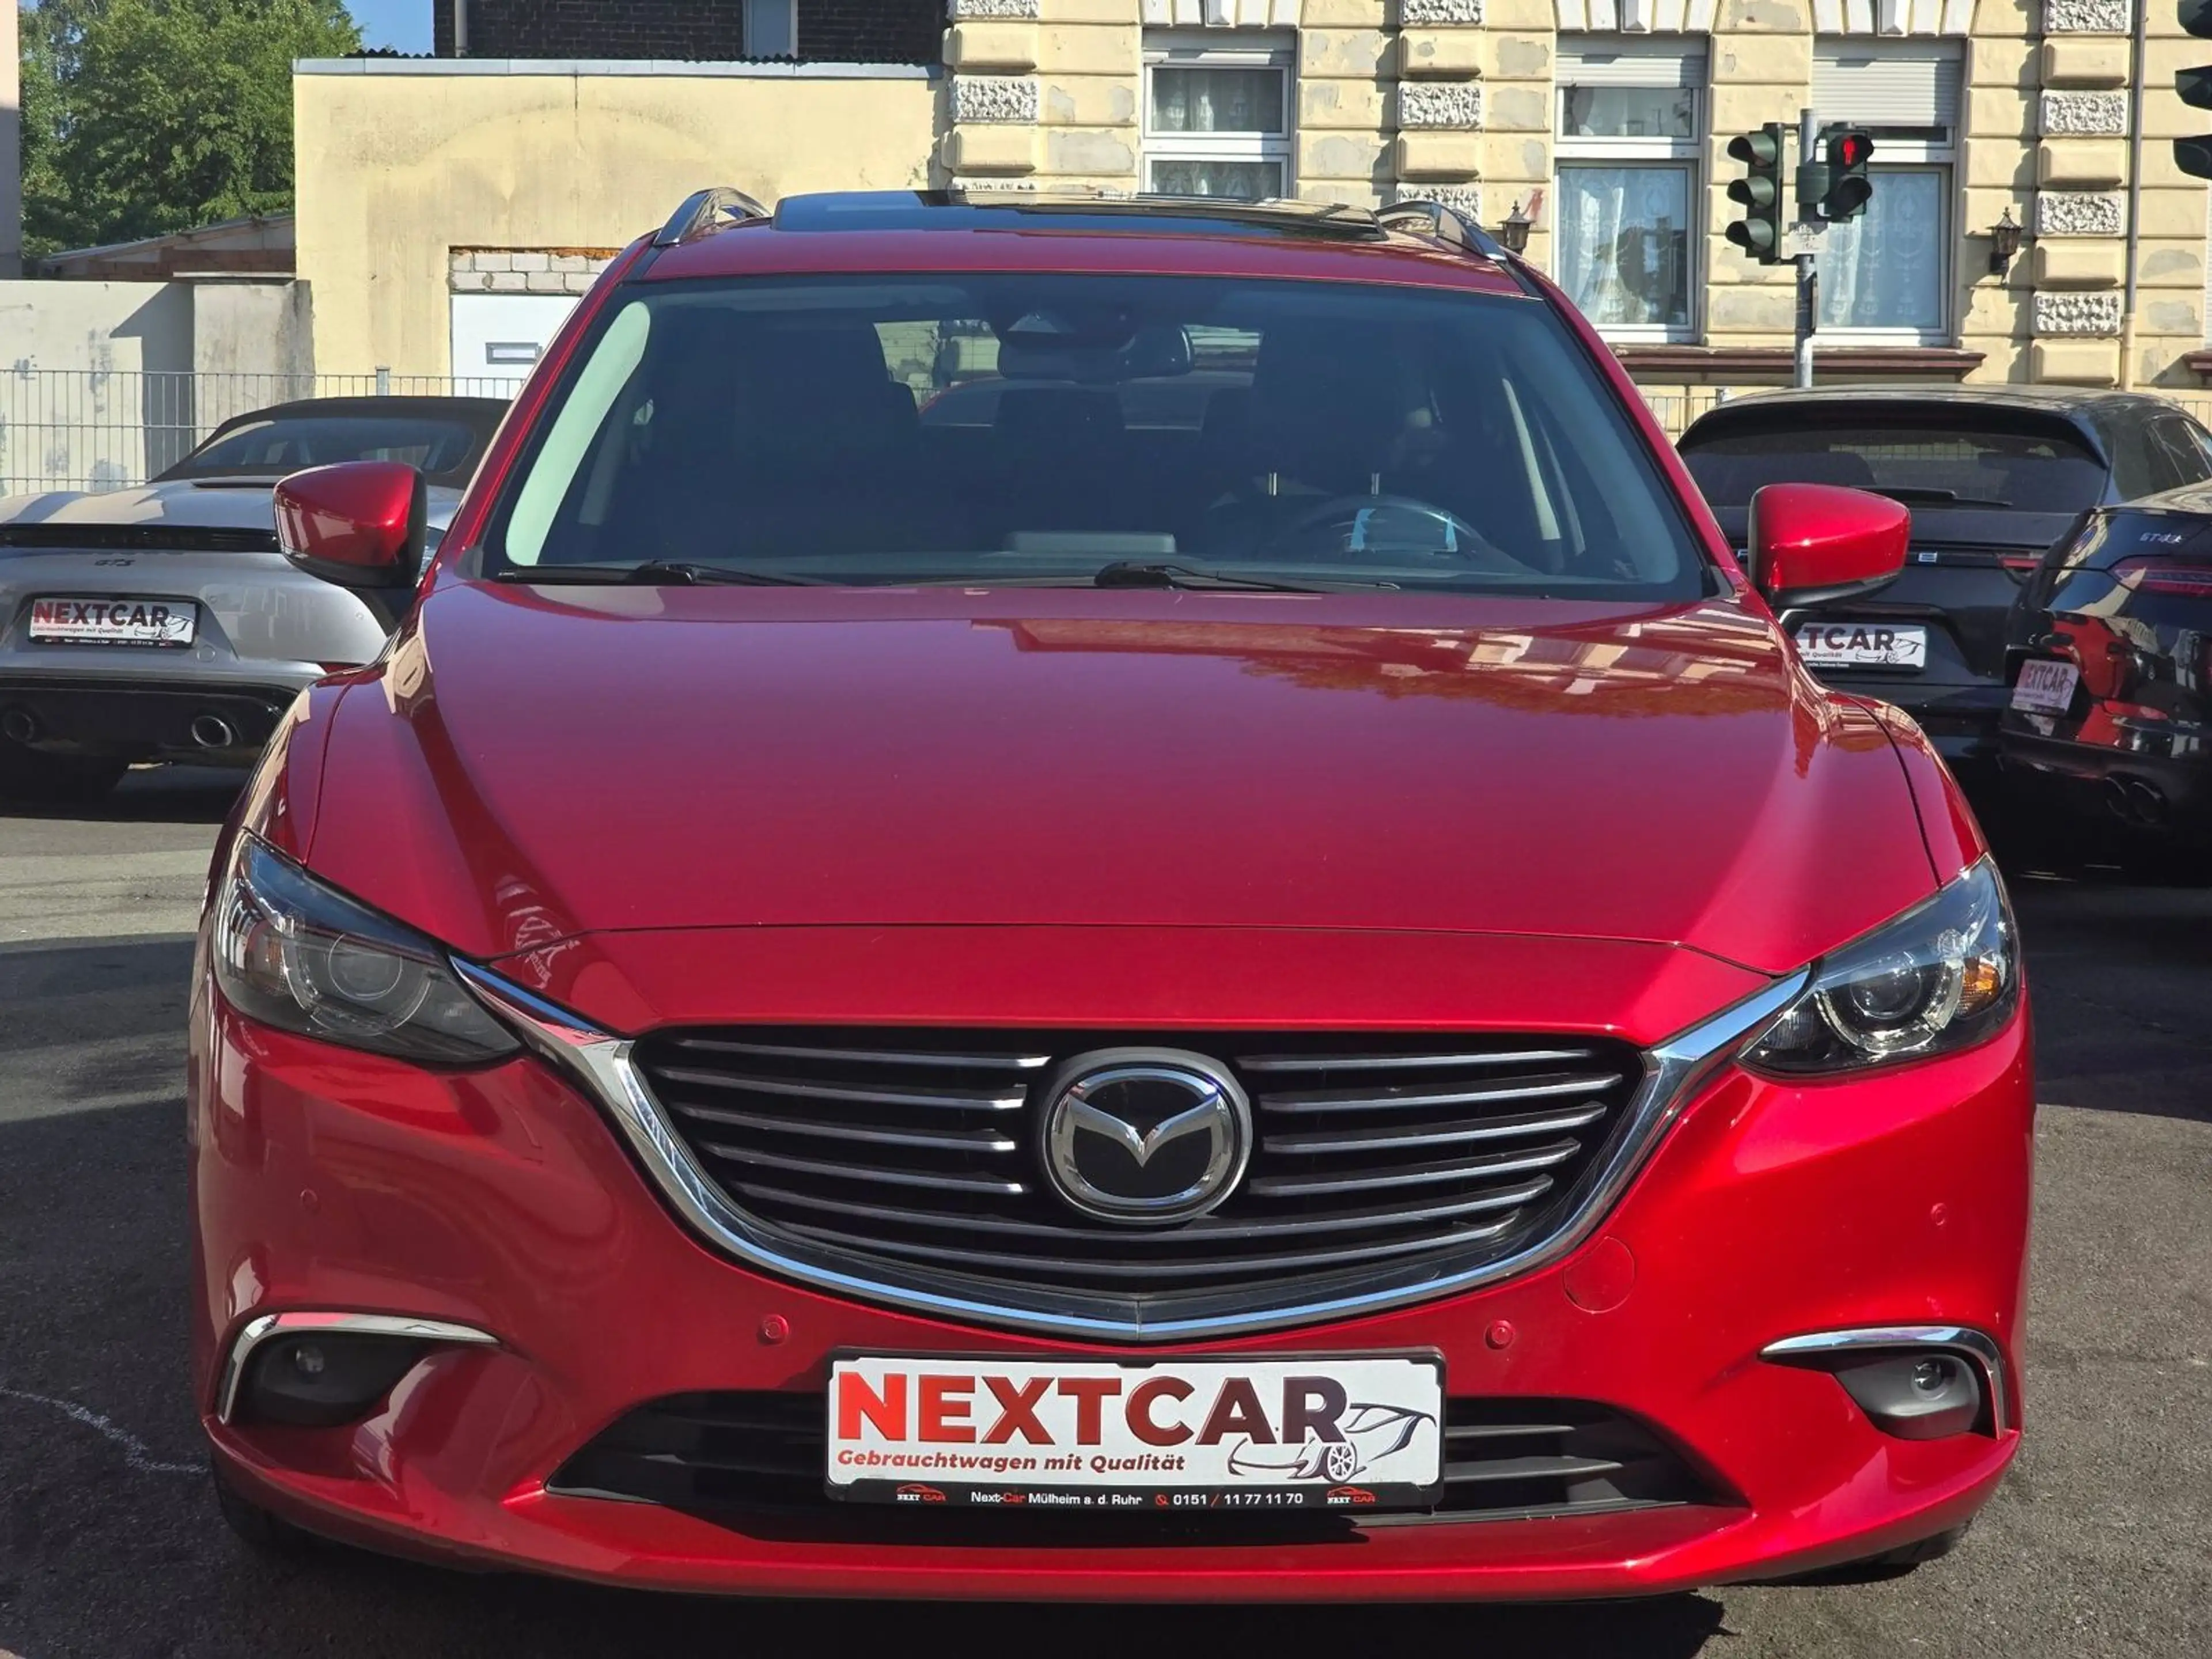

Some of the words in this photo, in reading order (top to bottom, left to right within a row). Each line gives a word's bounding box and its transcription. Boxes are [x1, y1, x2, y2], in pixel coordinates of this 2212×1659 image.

[34, 602, 170, 627] NEXTCAR
[838, 1371, 1347, 1446] NEXTCAR
[838, 1450, 1037, 1472] Gebrauchtwagen
[1044, 1453, 1082, 1470] mit
[1090, 1453, 1185, 1473] Qualität
[971, 1491, 1025, 1503] Next-Car
[1028, 1492, 1081, 1504] Mülheim
[1111, 1494, 1143, 1505] Ruhr
[1173, 1494, 1207, 1505] 0151
[1224, 1494, 1240, 1505] 11
[1244, 1494, 1261, 1505] 77
[1266, 1493, 1281, 1504] 11
[1286, 1493, 1303, 1504] 70
